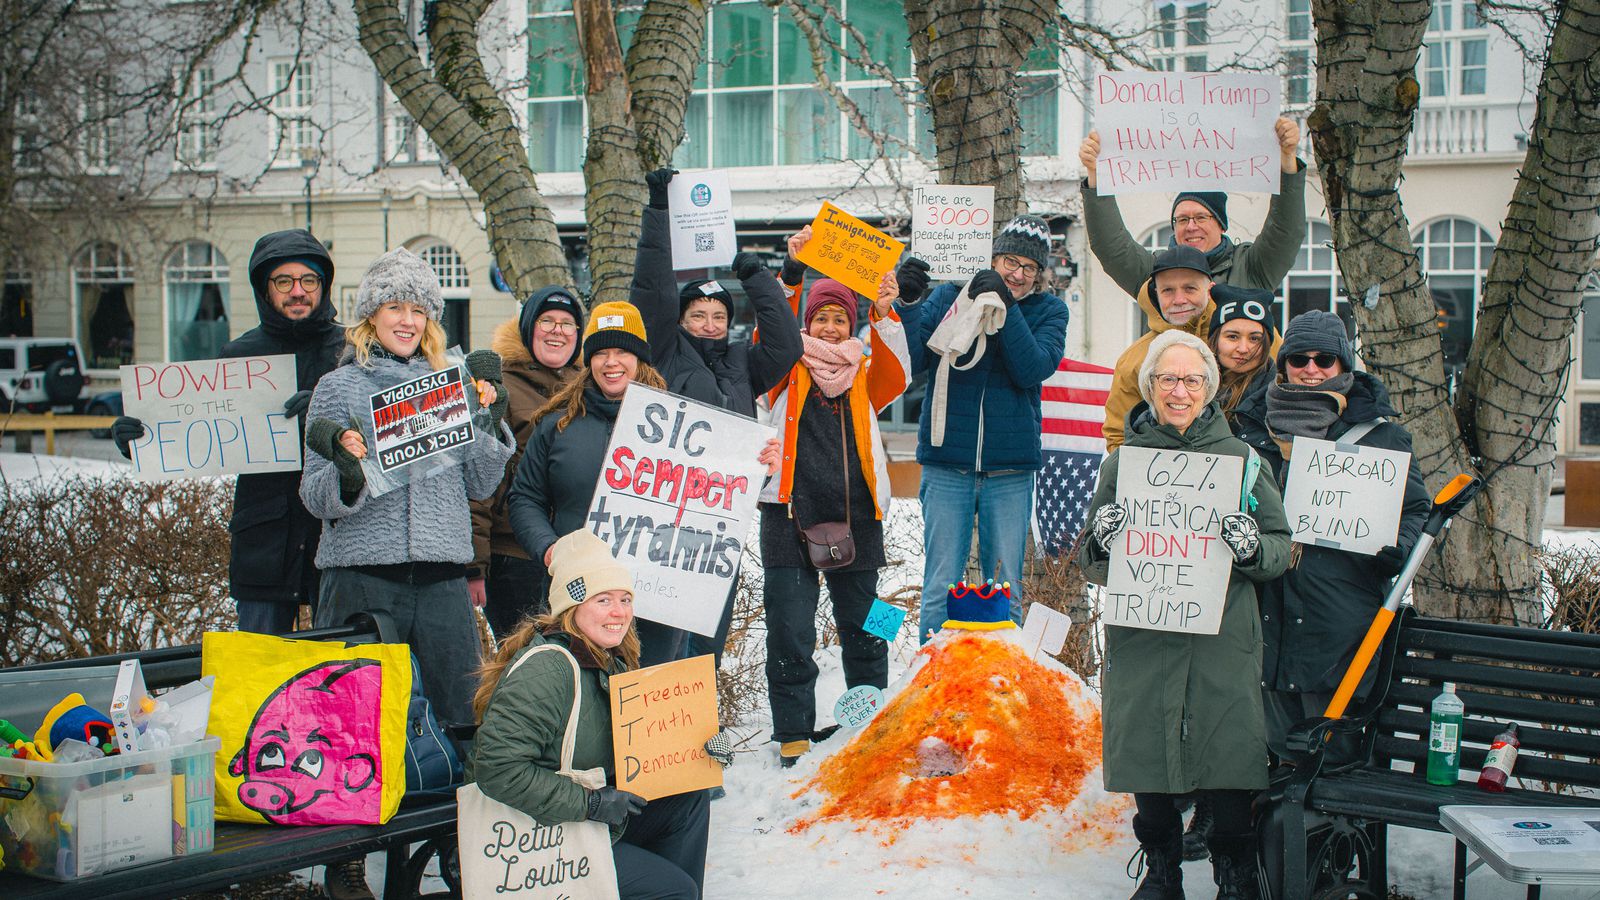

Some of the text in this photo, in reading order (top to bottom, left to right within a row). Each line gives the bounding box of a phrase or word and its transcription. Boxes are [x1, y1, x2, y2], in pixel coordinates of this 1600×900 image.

[1098, 73, 1271, 118] Donald Trump
[1160, 108, 1203, 126] is a
[1116, 127, 1236, 150] HUMAN
[1099, 155, 1271, 187] TRAFFICKER
[914, 187, 973, 206] There are
[927, 206, 989, 226] 3000
[914, 228, 991, 245] peaceful protests
[934, 243, 967, 255] against
[914, 251, 986, 264] Donald Trump
[937, 264, 952, 274] US
[956, 266, 980, 275] toda
[134, 359, 277, 400] POWER
[381, 372, 449, 404] DYSTOPIA
[170, 399, 237, 416] TO THE
[132, 413, 297, 473] PEOPLE
[383, 426, 470, 466] FUCK YOUR
[1146, 452, 1219, 491] 62%
[1307, 449, 1396, 487] ABROAD,
[1165, 492, 1183, 509] of
[1311, 489, 1352, 509] NOT
[1122, 497, 1221, 533] AMERICA
[1295, 514, 1370, 539] BLIND
[1126, 529, 1217, 559] DIDN'T
[1126, 559, 1194, 587] VOTE
[1147, 582, 1176, 600] for
[868, 607, 898, 630] 8647
[1109, 593, 1202, 628] TRUMP
[619, 680, 704, 715] Freedom
[838, 688, 864, 707] WORST
[842, 697, 868, 717] PREZ
[621, 708, 693, 746] Truth
[495, 848, 590, 894] Loutre
